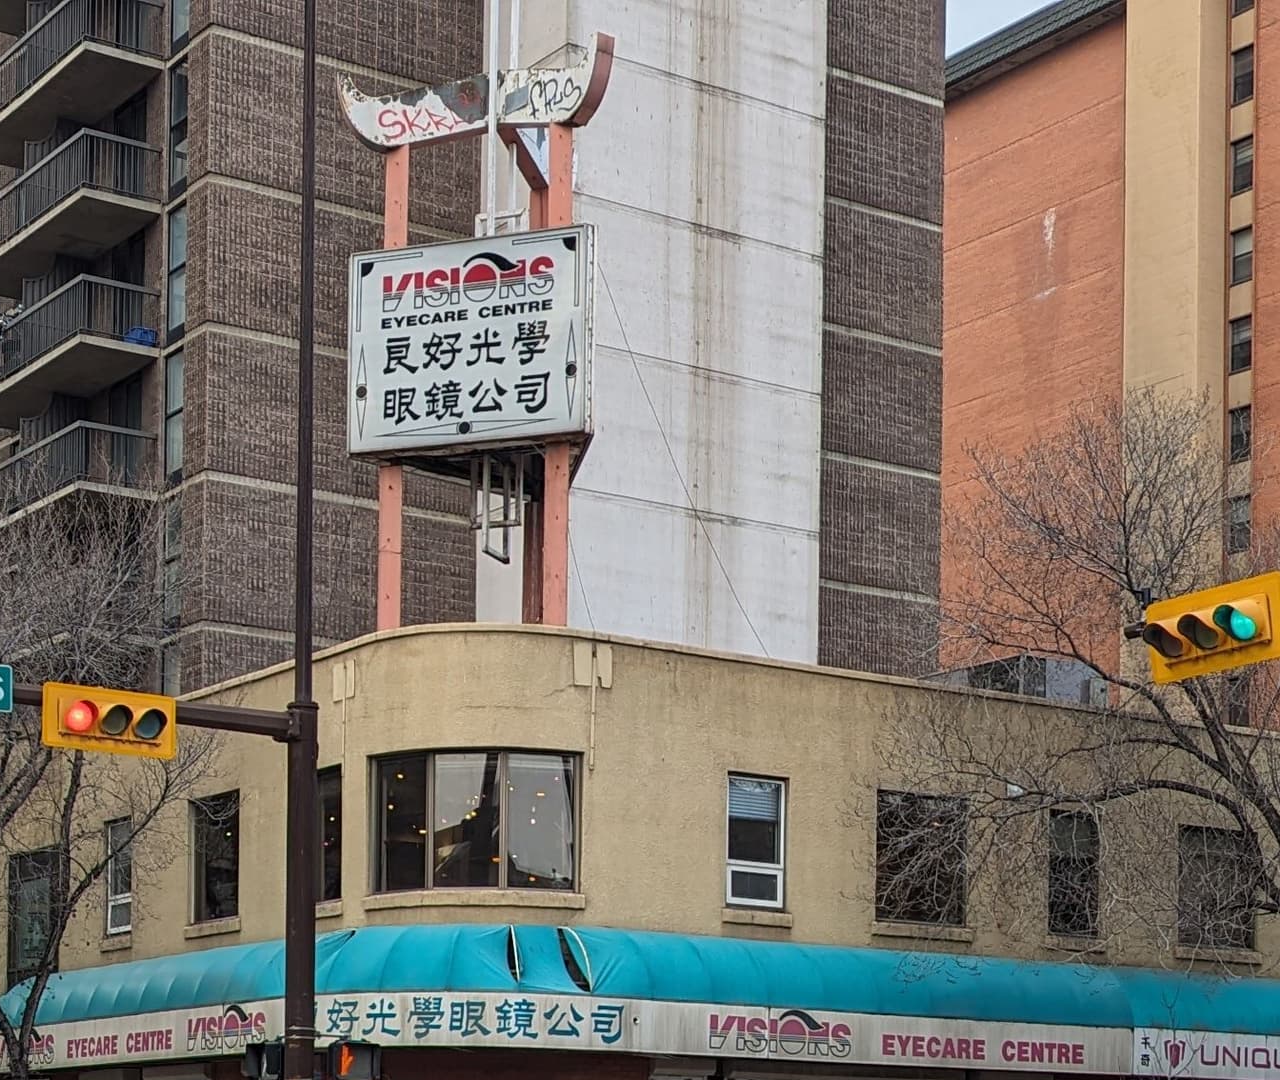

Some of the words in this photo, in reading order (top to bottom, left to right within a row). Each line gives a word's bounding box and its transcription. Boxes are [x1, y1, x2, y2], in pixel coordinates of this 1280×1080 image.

[383, 253, 554, 312] VISIONS
[381, 309, 468, 329] EYECARE
[478, 299, 553, 318] CENTRE
[384, 371, 550, 425] 眼鏡公司
[67, 1034, 118, 1059] EYECARE
[126, 1029, 173, 1053] CENTRE
[187, 1005, 266, 1052] VISIONS
[314, 996, 624, 1044] 好光學眼鏡公司
[709, 1010, 852, 1057] VISIONS
[882, 1034, 985, 1060] EYECARE
[1002, 1040, 1084, 1064] CENTRE
